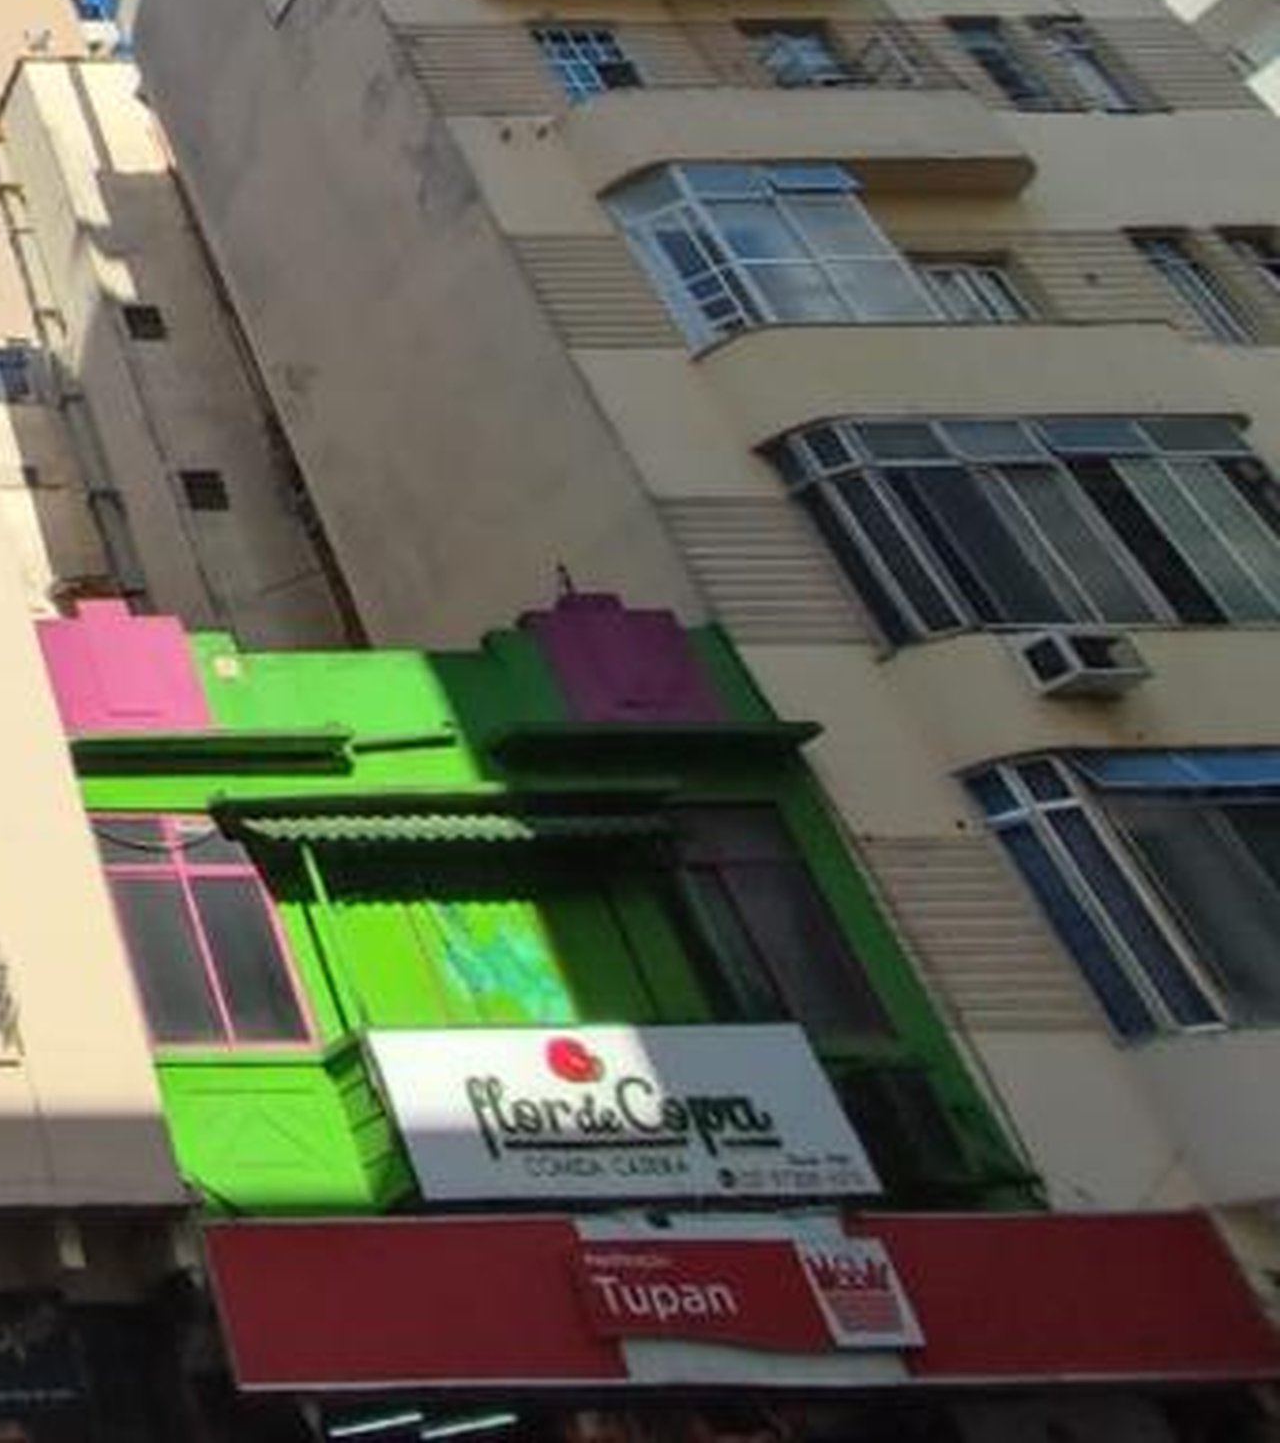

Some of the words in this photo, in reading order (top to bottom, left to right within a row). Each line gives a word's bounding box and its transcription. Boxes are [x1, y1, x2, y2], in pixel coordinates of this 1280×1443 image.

[466, 1073, 571, 1159] flor
[576, 1095, 621, 1134] de
[615, 1076, 772, 1159] Copa
[589, 1275, 739, 1322] Tupan
